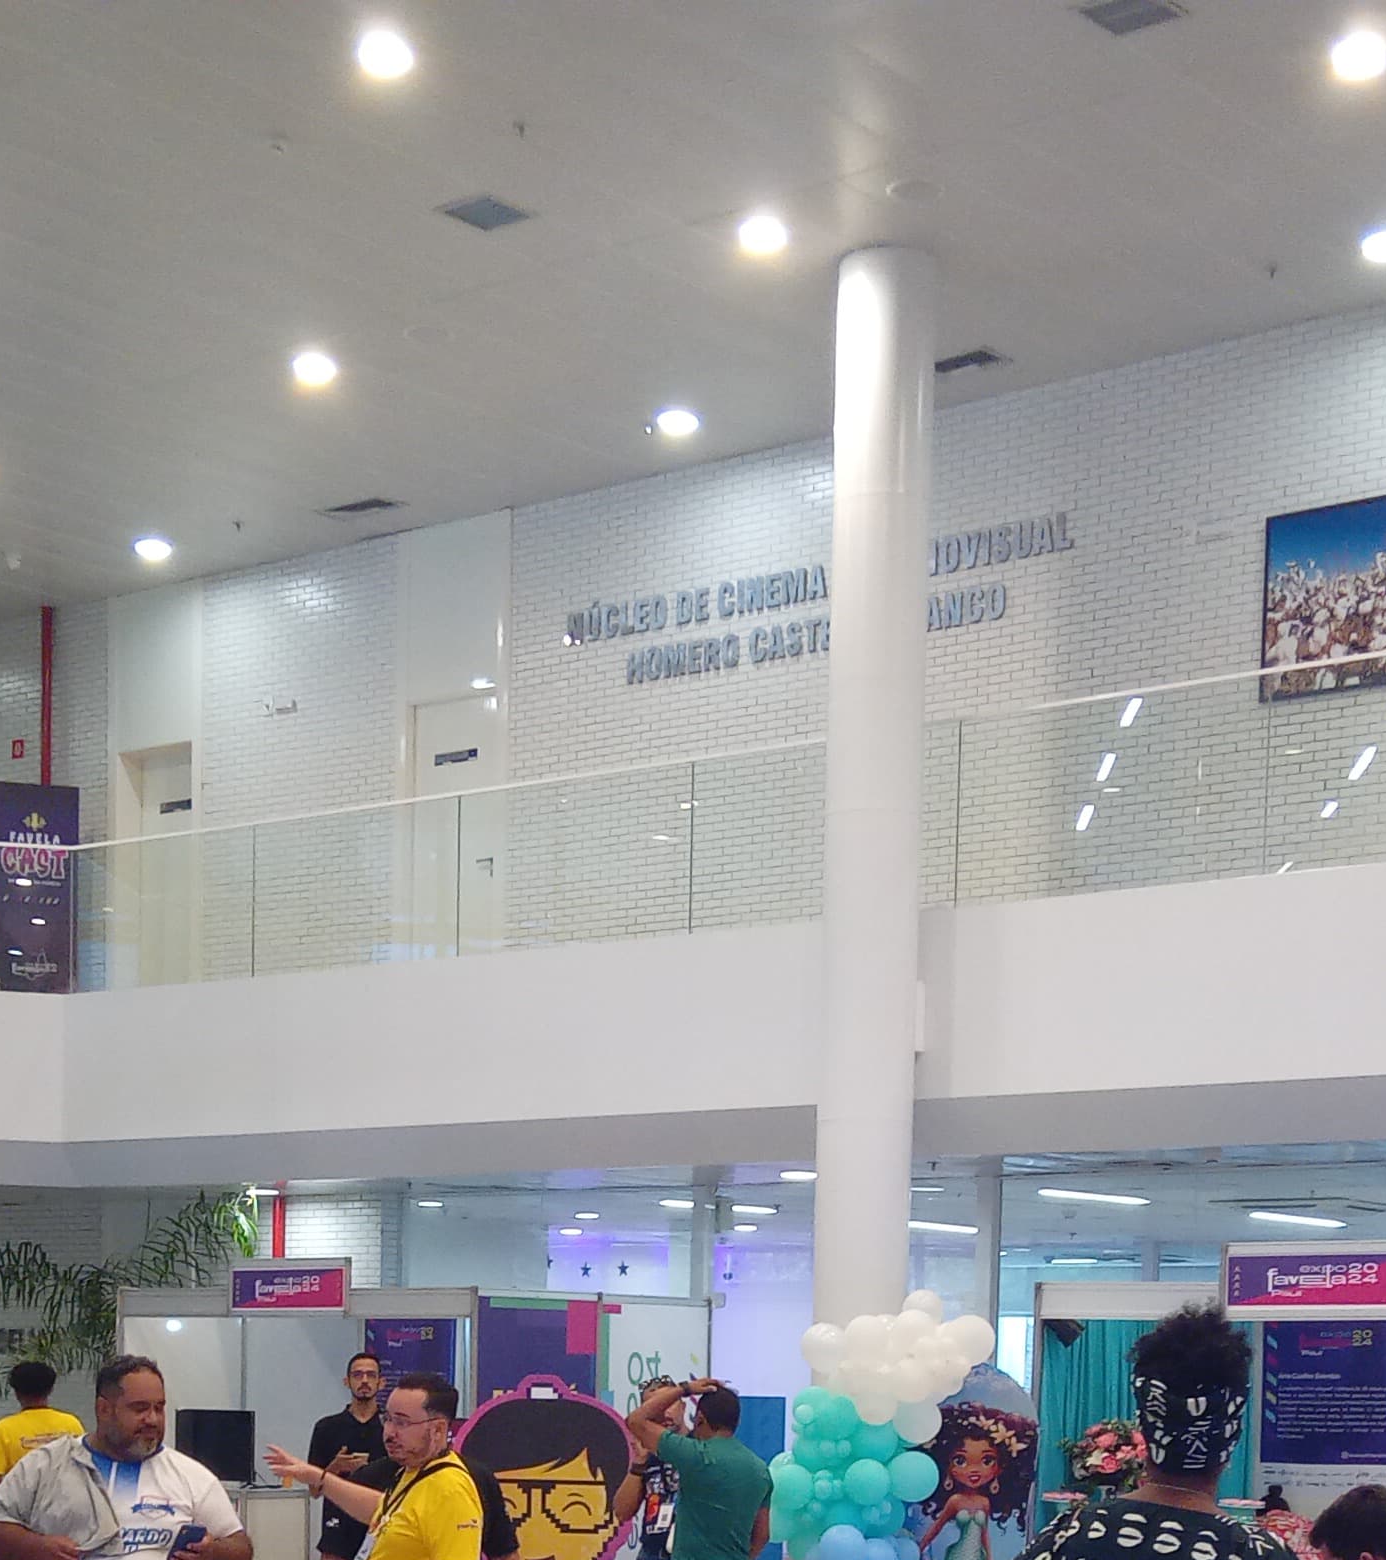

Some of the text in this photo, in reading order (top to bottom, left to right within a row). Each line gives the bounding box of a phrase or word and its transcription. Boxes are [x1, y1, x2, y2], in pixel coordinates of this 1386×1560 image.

[566, 511, 1075, 644] NÚCLEO DE CINEMA IOVISUAL
[626, 583, 1007, 685] HOMERO CASTE ANCO
[0, 846, 69, 879] CAST
[1347, 1274, 1379, 1285] 24
[1348, 1262, 1380, 1274] 20
